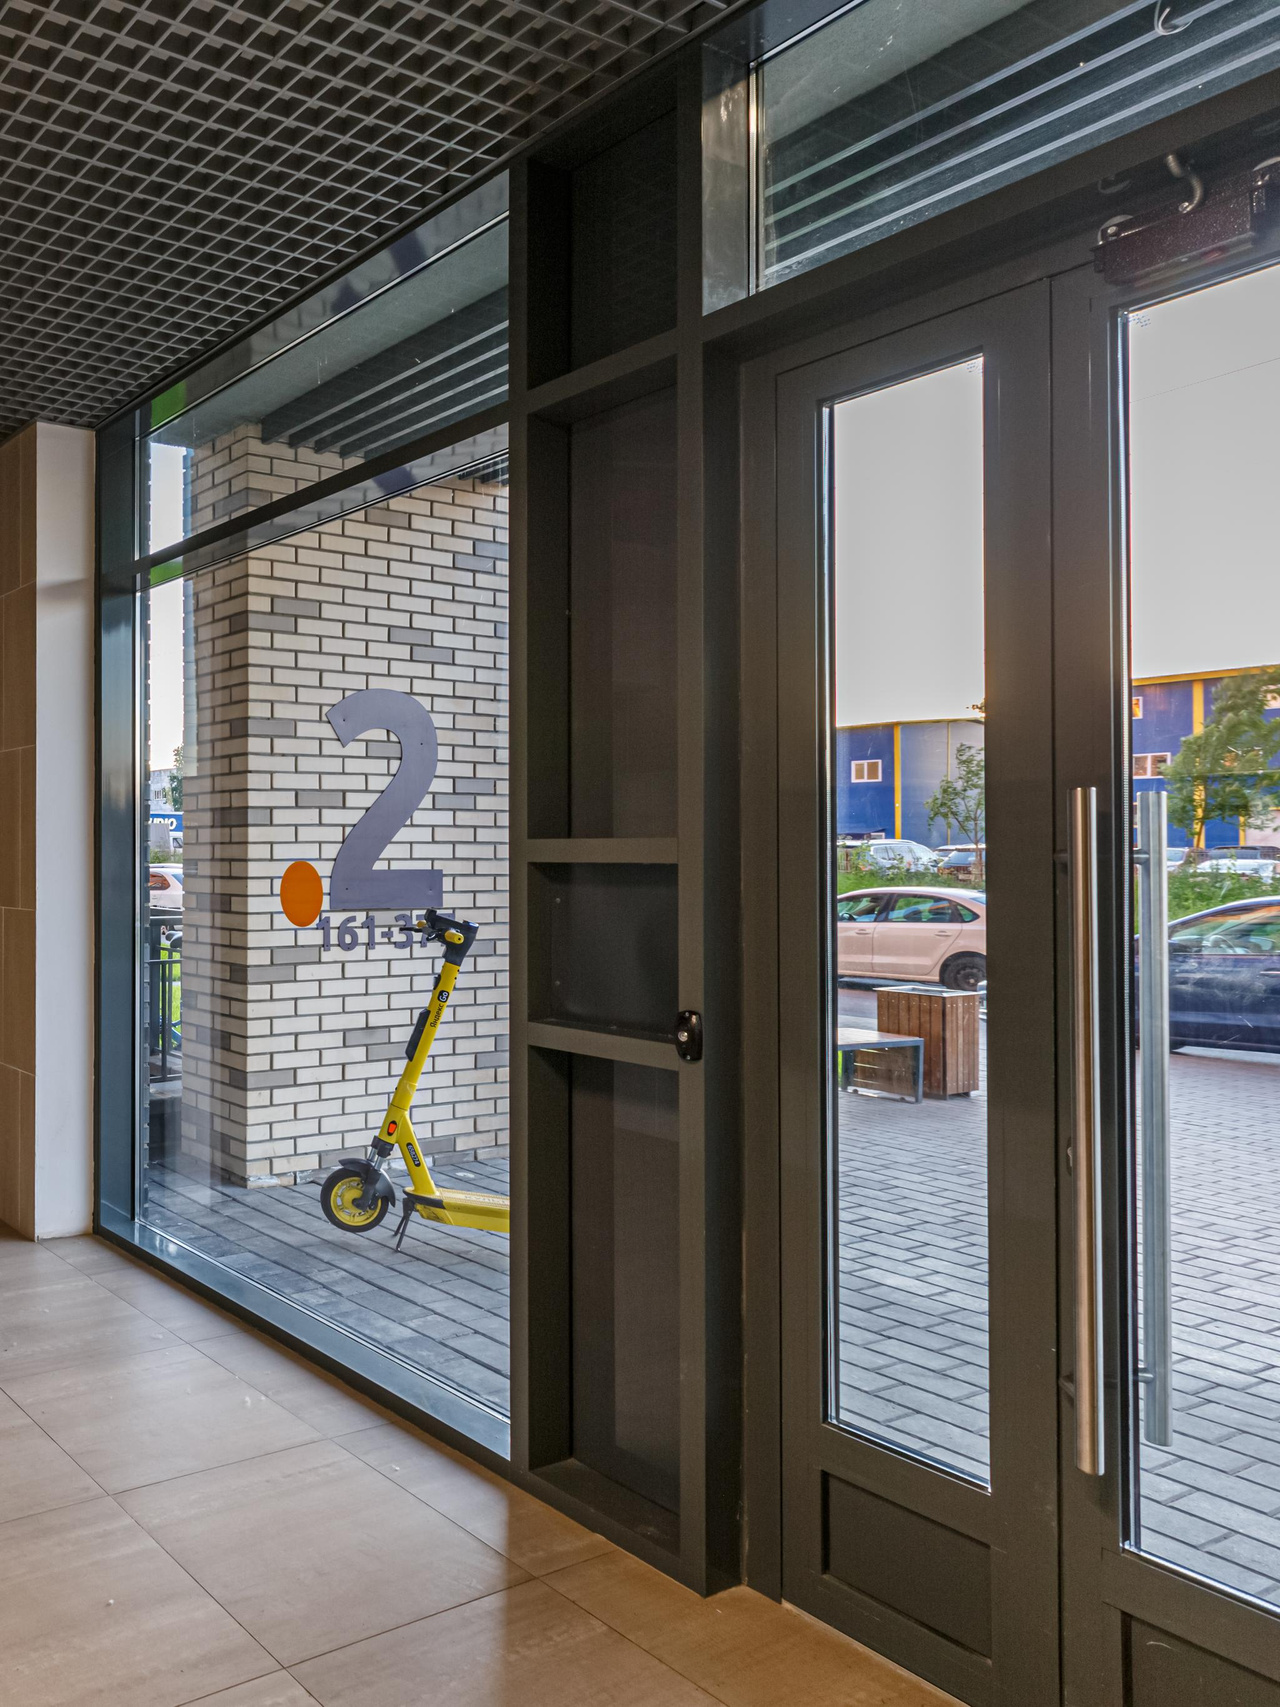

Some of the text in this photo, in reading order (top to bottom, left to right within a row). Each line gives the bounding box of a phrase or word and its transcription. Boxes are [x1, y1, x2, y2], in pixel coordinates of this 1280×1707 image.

[326, 688, 443, 909] 2
[430, 991, 449, 1029] Яндекс Go
